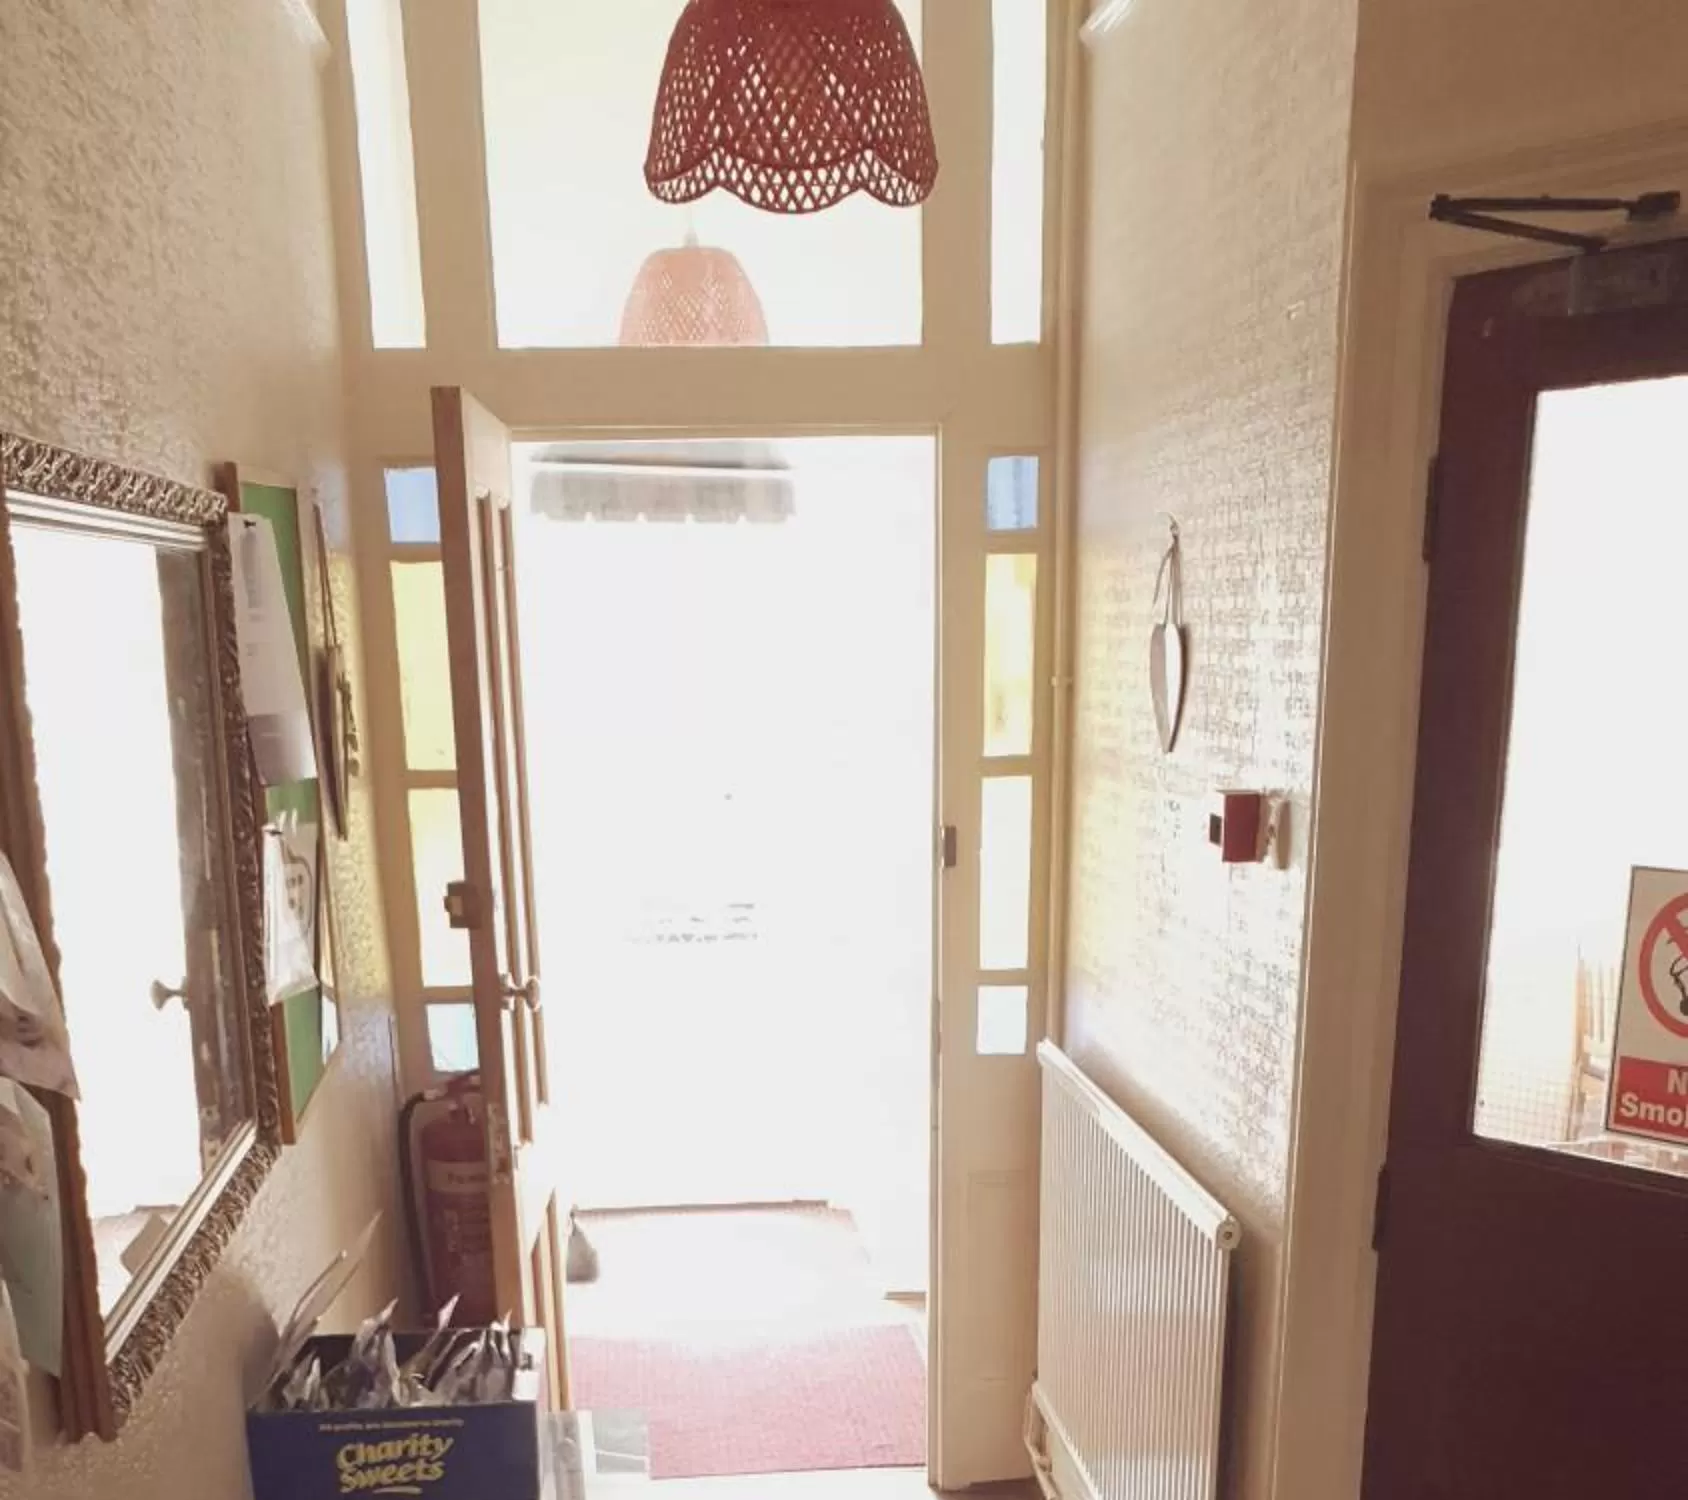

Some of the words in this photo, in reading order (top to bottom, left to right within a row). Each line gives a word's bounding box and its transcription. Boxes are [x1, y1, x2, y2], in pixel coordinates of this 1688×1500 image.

[1620, 1091, 1688, 1128] Smo
[336, 1433, 454, 1467] Charity
[340, 1458, 445, 1493] Sweets
